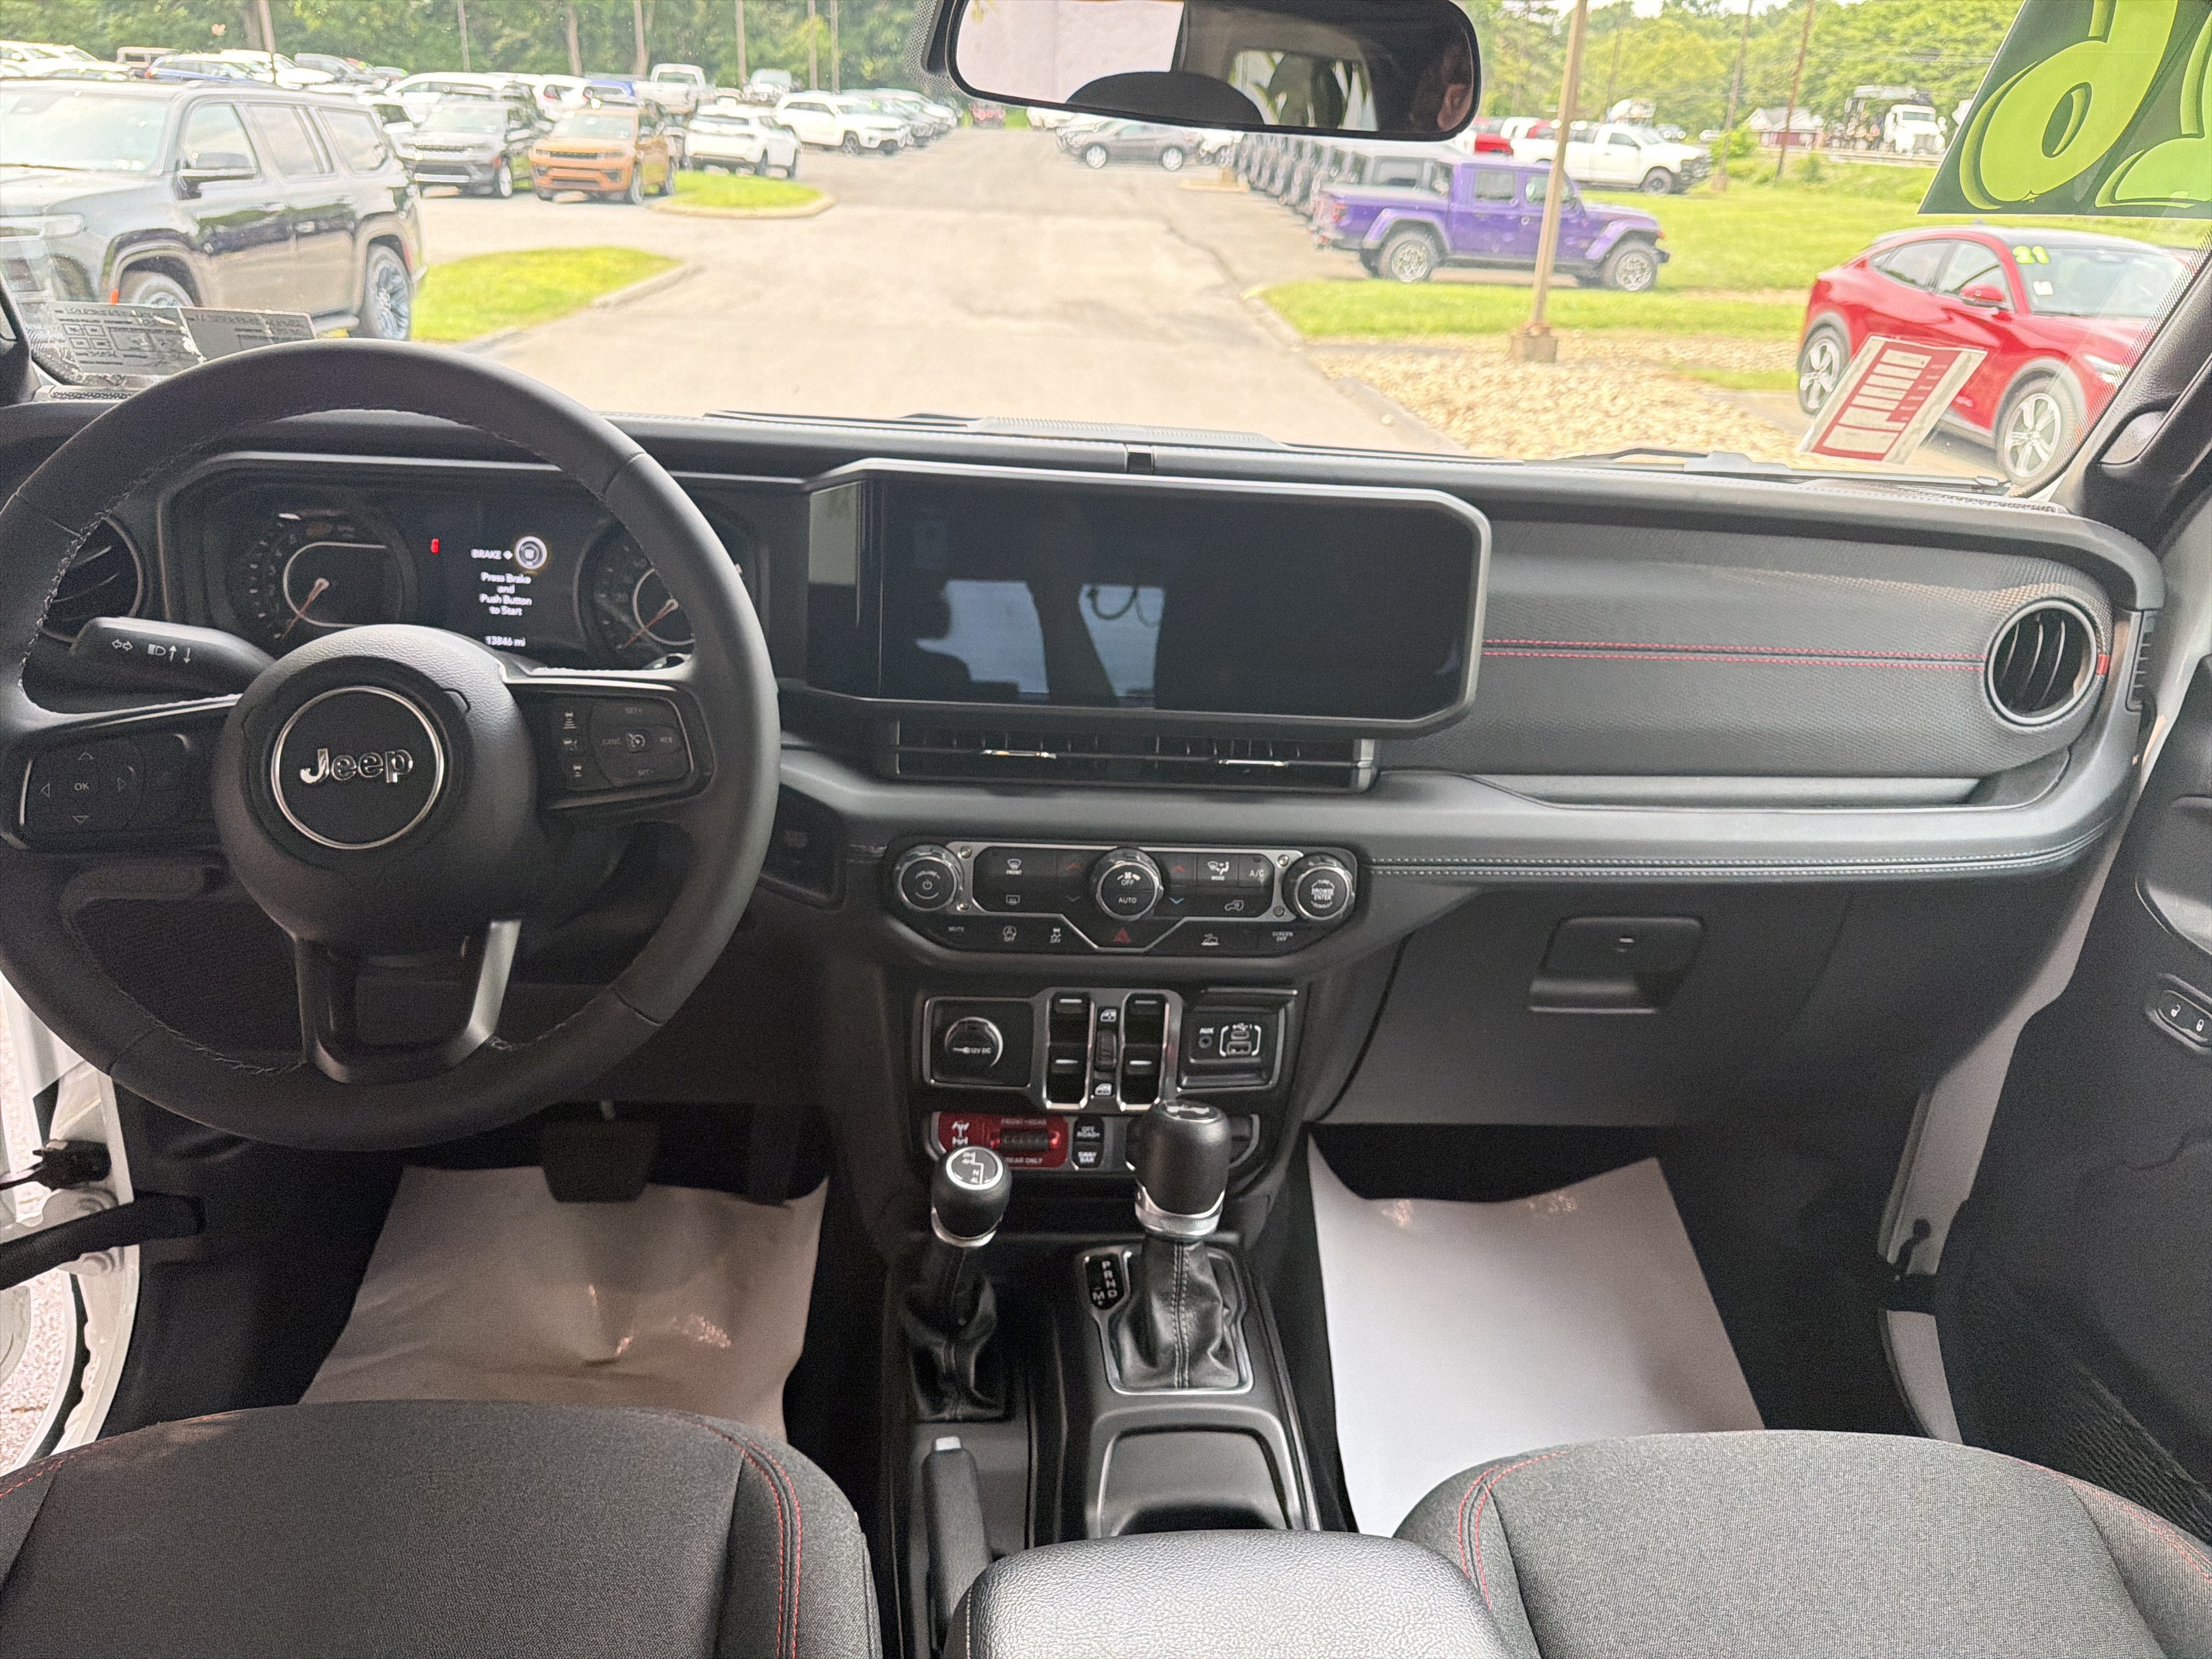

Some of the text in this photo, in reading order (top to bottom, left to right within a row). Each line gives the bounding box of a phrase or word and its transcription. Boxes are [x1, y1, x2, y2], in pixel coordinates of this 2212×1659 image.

[2012, 246, 2050, 264] 21
[471, 549, 502, 560] BRAKE
[481, 572, 531, 584] Press Brake
[496, 584, 515, 594] and
[479, 593, 532, 606] Push Button
[489, 606, 522, 616] to Start
[514, 637, 526, 647] mi
[300, 747, 413, 784] Jeep
[74, 782, 89, 791] OK
[1249, 870, 1265, 878] A/C
[1102, 1261, 1111, 1269] P
[1104, 1270, 1113, 1279] R
[1105, 1279, 1116, 1288] N
[1092, 1291, 1105, 1300] M
[1108, 1290, 1118, 1298] D
